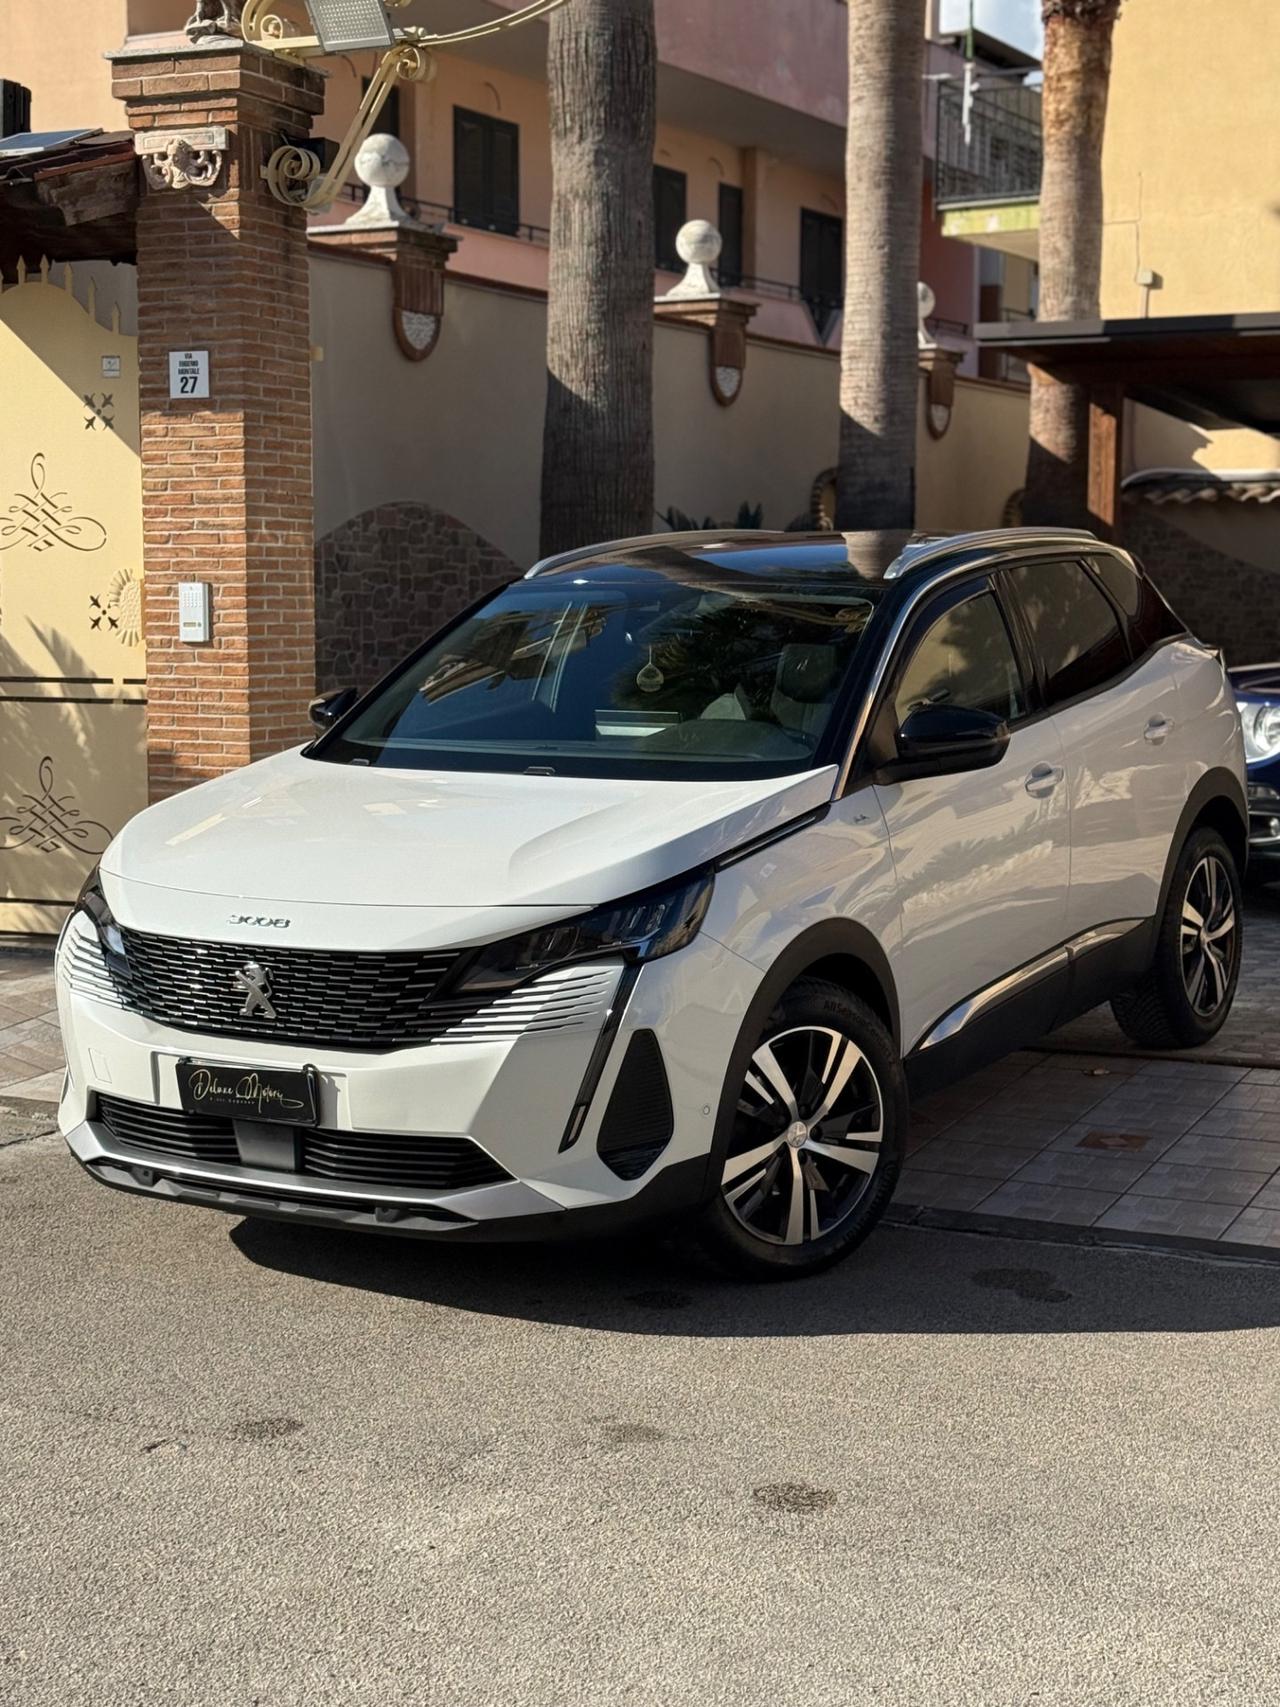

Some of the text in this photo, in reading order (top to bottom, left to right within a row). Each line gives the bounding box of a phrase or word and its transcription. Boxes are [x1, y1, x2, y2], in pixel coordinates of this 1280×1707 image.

[180, 376, 198, 394] 27
[228, 914, 291, 929] 3008
[188, 1068, 234, 1101] Deluxe
